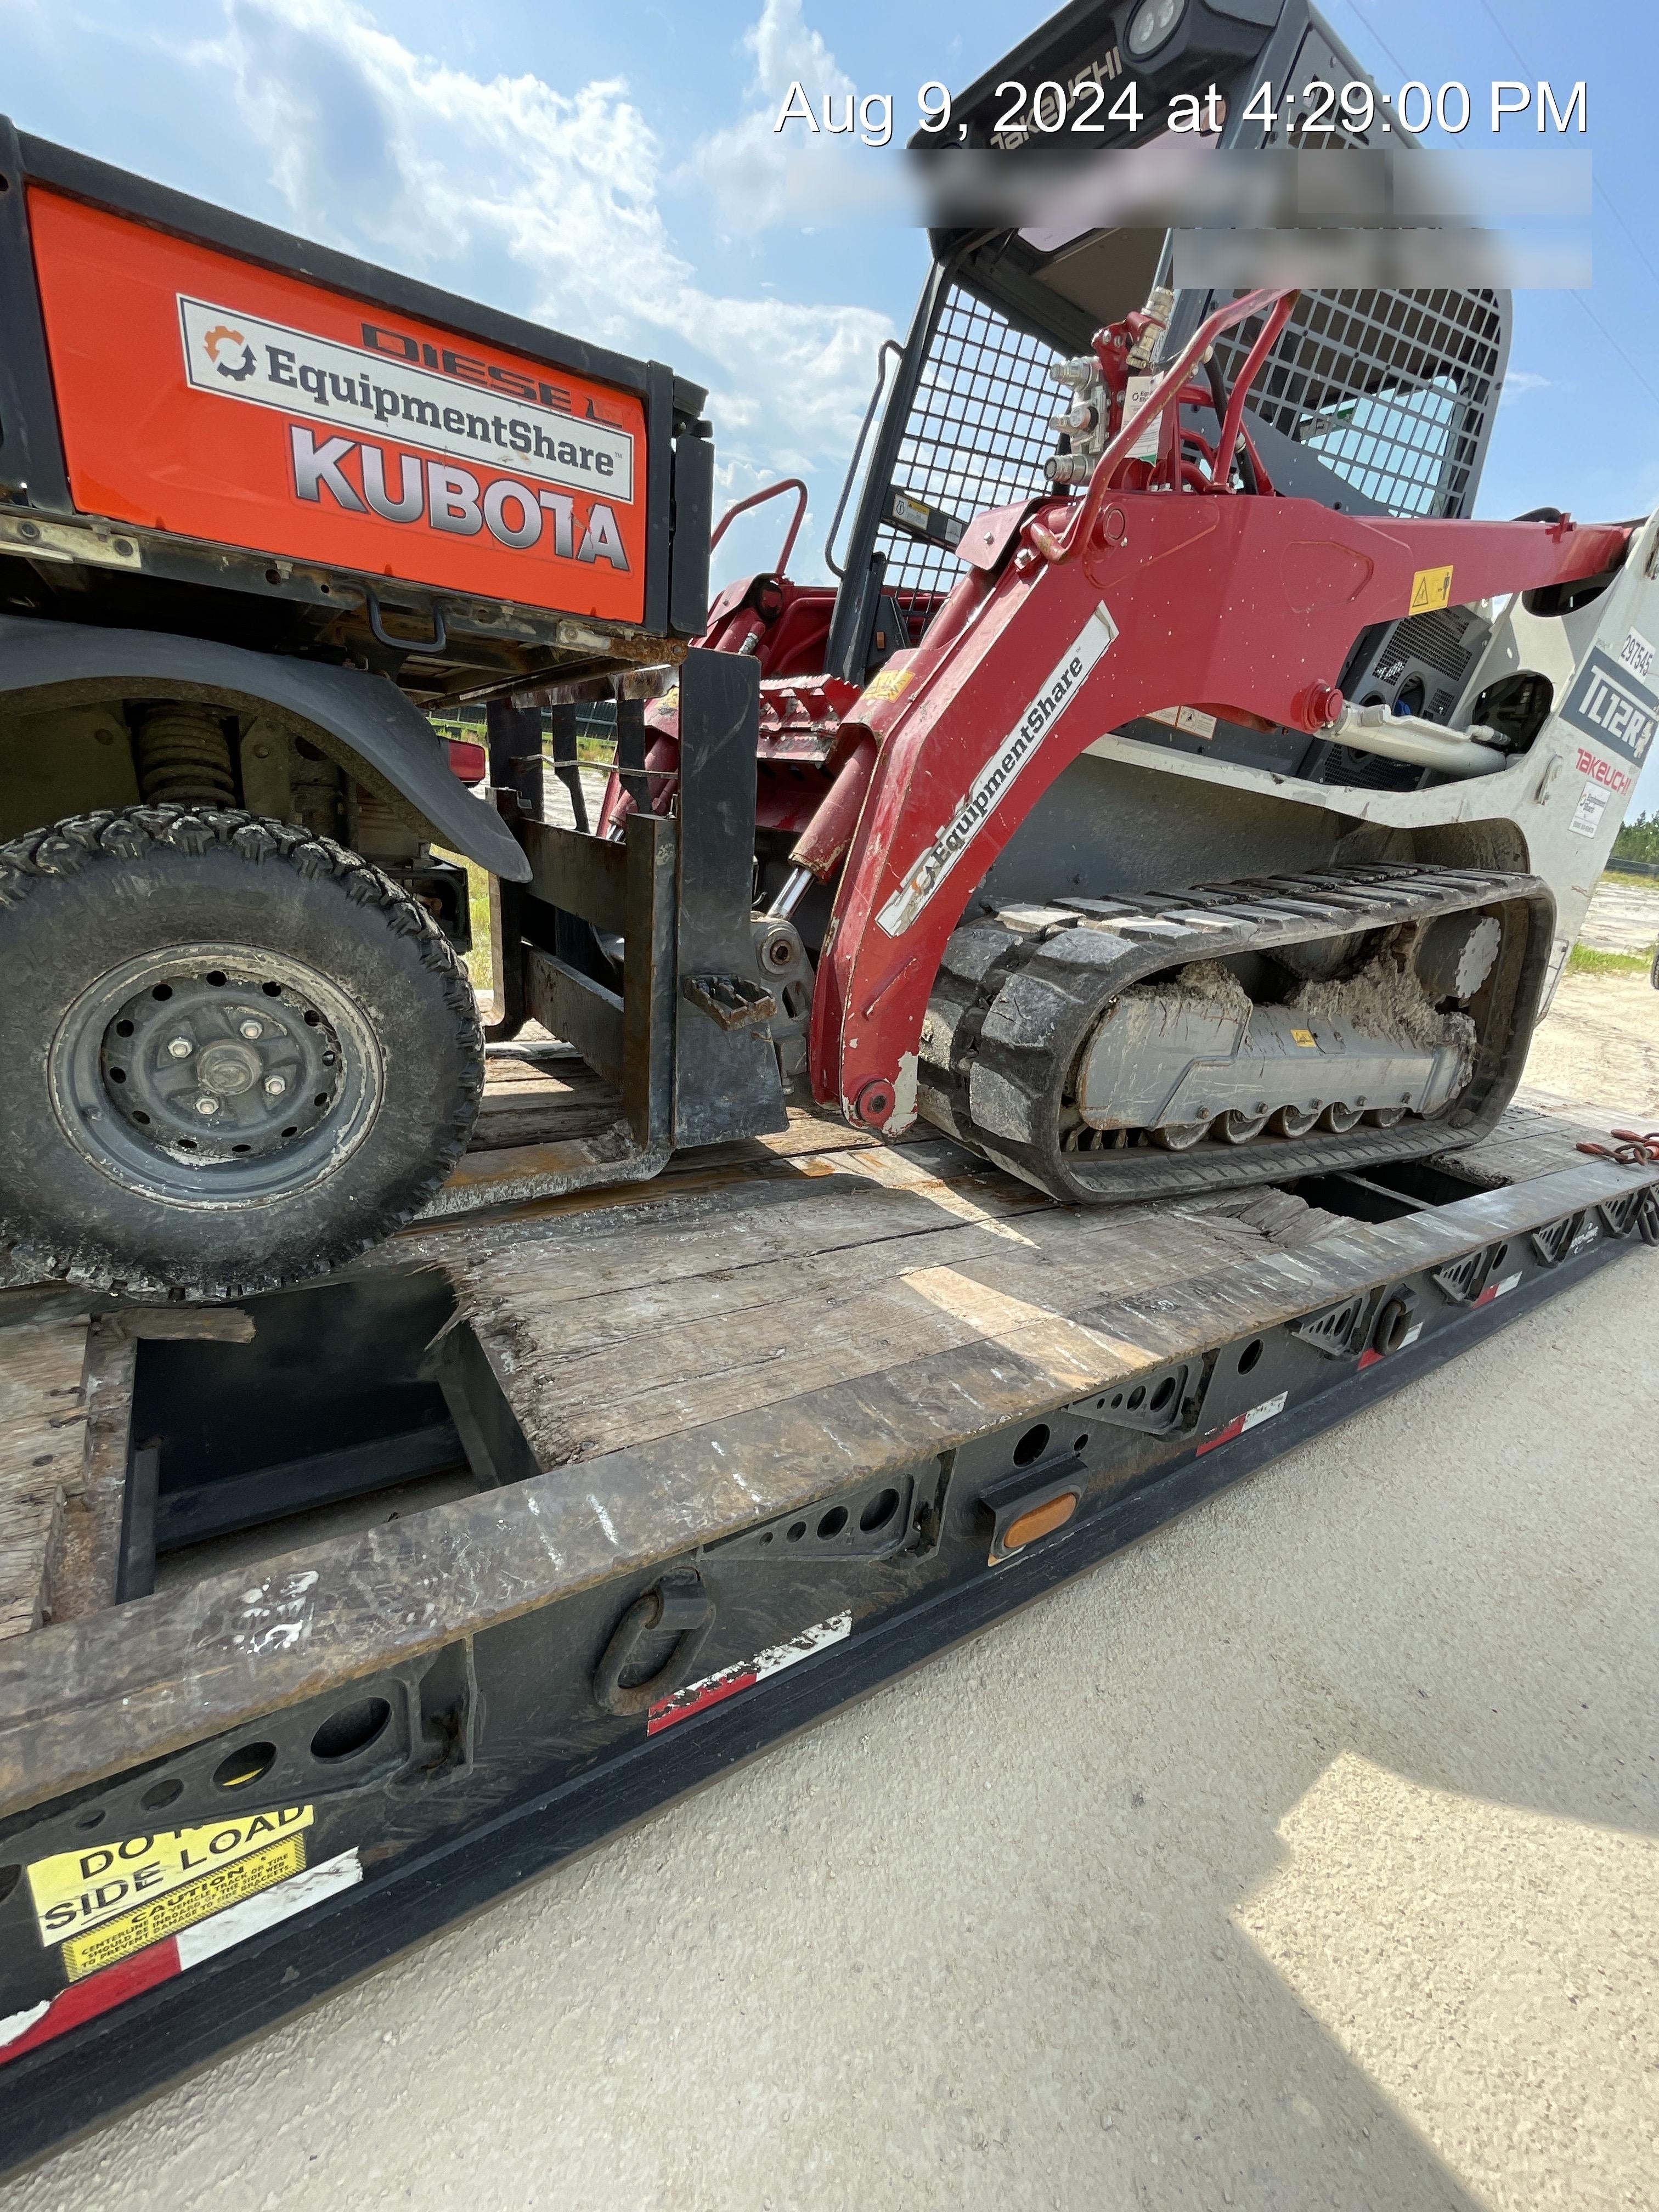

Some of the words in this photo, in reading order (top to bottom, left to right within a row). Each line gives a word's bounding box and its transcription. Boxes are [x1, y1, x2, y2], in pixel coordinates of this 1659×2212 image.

[362, 323, 622, 428] DIESEL
[290, 425, 630, 572] KUBOTA
[1621, 634, 1653, 676] 297545
[1576, 748, 1632, 795] TAKEUCHI
[80, 1835, 154, 1880] DO
[180, 1806, 305, 1870] LOAD
[45, 1861, 163, 1930] SIDE
[82, 1920, 149, 1955] CENTERLINE
[170, 1890, 211, 1913] VEHICLE
[215, 1872, 247, 1891] TRACK
[251, 1866, 264, 1874] OR
[267, 1853, 289, 1866] TIRE
[88, 1935, 131, 1958] SHOULD
[136, 1926, 149, 1936] BE
[153, 1901, 201, 1928] INBOARD
[221, 1883, 239, 1895] THE
[243, 1872, 262, 1884] SIDE
[266, 1862, 285, 1873] WEB
[132, 1866, 244, 1923] CAUTION
[82, 1959, 95, 1967] TO
[100, 1932, 149, 1959] PREVENT
[153, 1909, 197, 1933] DAMAGE
[201, 1901, 213, 1910] TO
